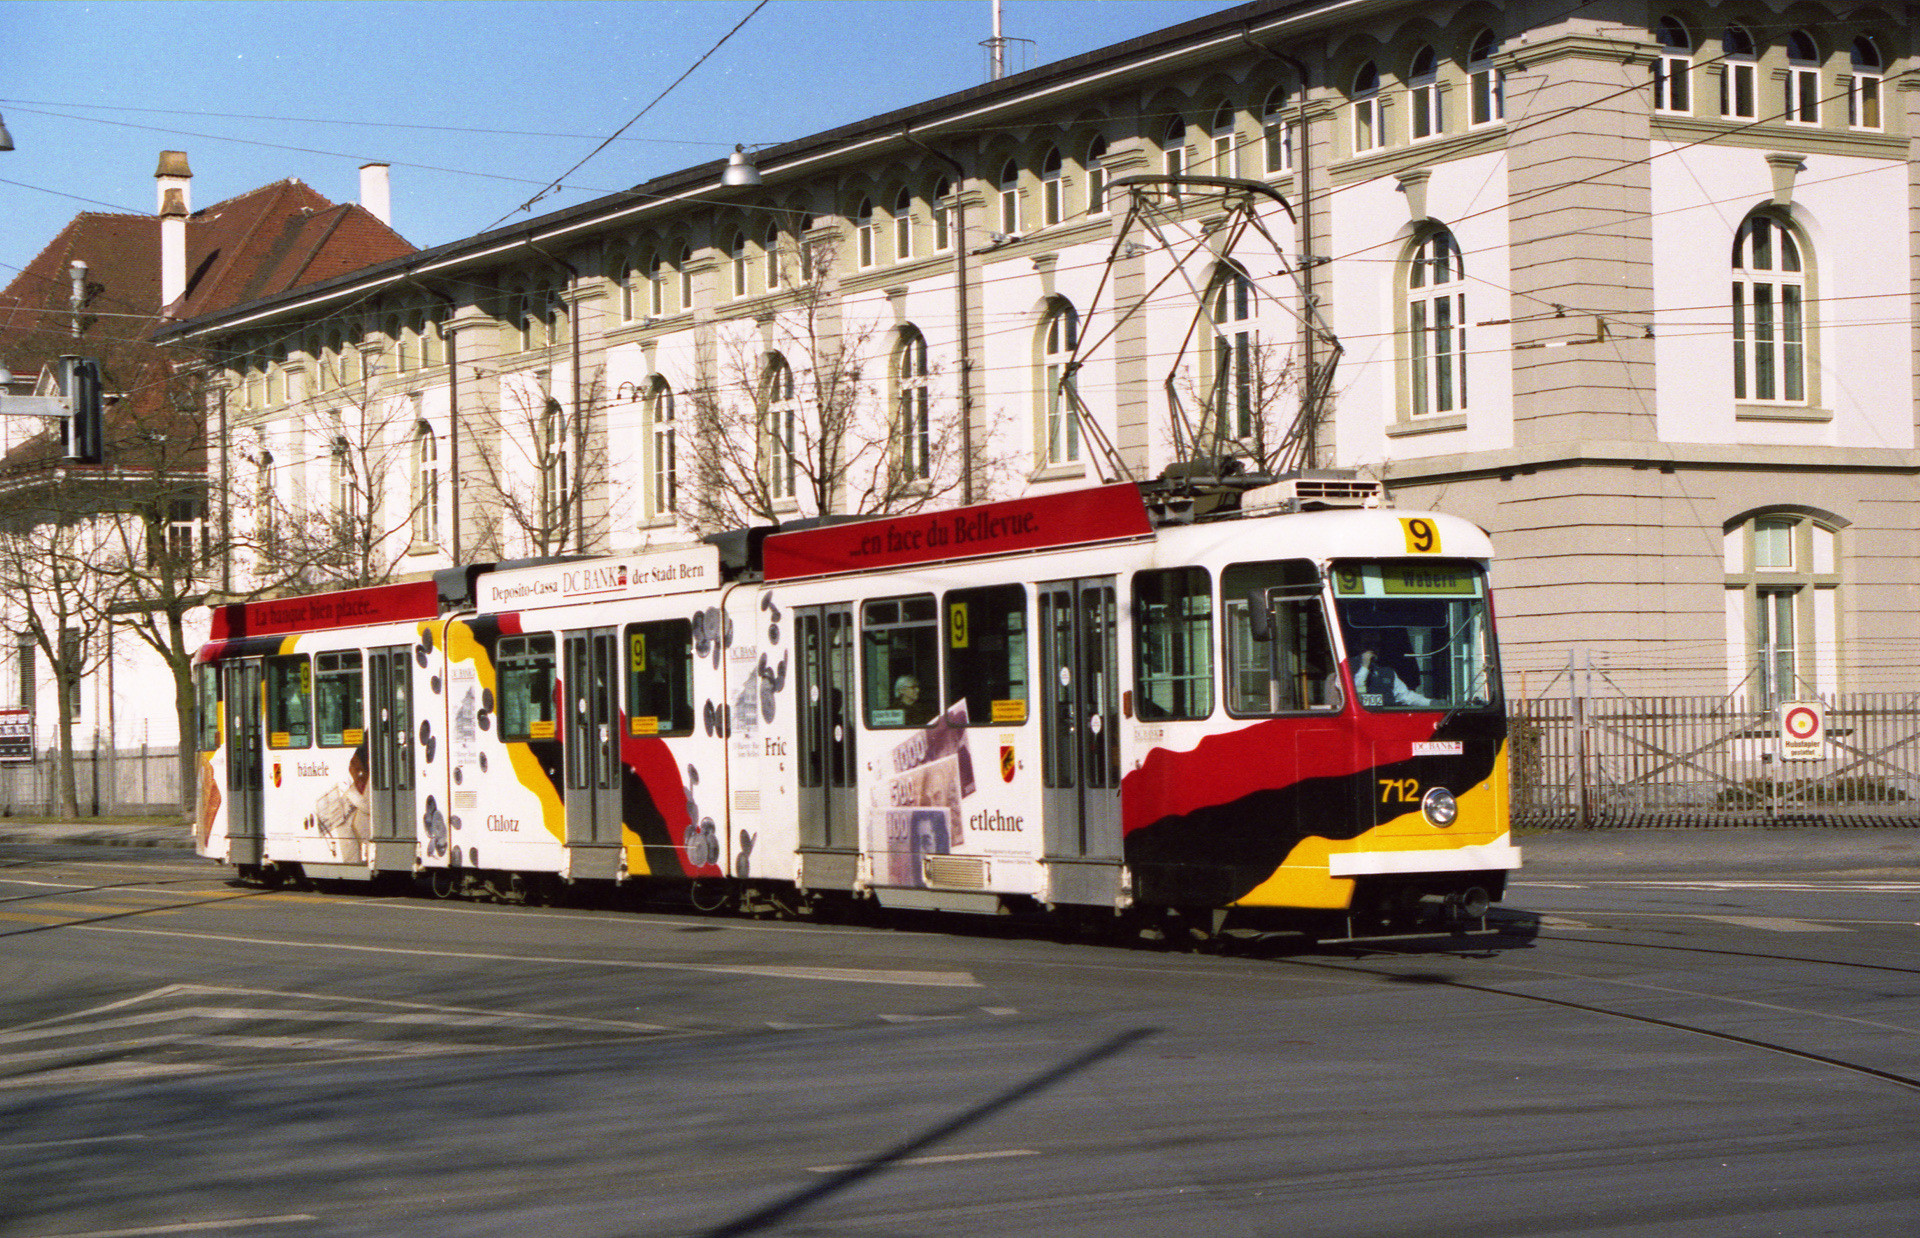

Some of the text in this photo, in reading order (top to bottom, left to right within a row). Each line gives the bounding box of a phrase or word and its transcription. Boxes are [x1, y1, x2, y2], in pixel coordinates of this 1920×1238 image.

[886, 524, 922, 553] face
[926, 519, 949, 548] du
[954, 510, 1040, 544] Bellevue.
[1408, 519, 1433, 552] 9
[563, 566, 618, 593] DC BANK
[632, 563, 705, 585] der Stadt Bern
[1341, 569, 1456, 590] 9 Wabern
[492, 579, 558, 604] Deposito-Cassa
[255, 608, 267, 626] La
[270, 604, 306, 629] banque
[309, 601, 334, 621] bien
[953, 609, 966, 641] 9
[634, 639, 643, 667] 9
[302, 666, 309, 689] 9
[765, 736, 787, 756] Fric
[1430, 742, 1454, 750] BANK
[1379, 778, 1420, 803] 712
[487, 815, 520, 832] Chlotz
[970, 811, 1024, 832] etlehne
